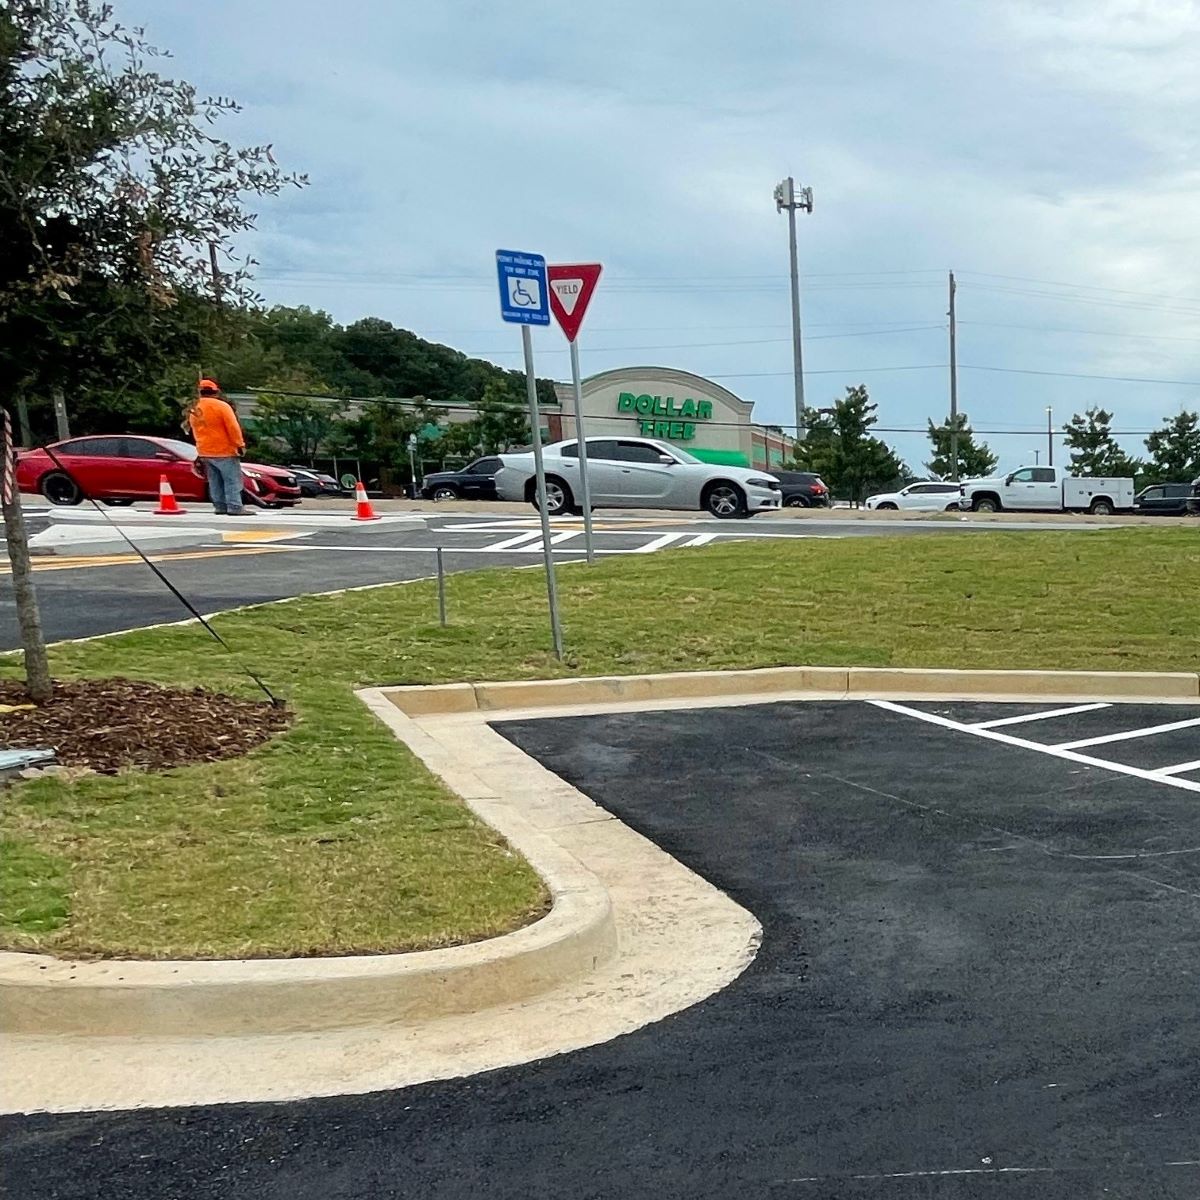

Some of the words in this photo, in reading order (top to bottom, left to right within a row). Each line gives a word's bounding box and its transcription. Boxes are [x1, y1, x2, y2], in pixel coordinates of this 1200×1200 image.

[556, 285, 578, 294] YIELD
[619, 392, 712, 418] DOLLAR
[638, 419, 696, 439] TREE
